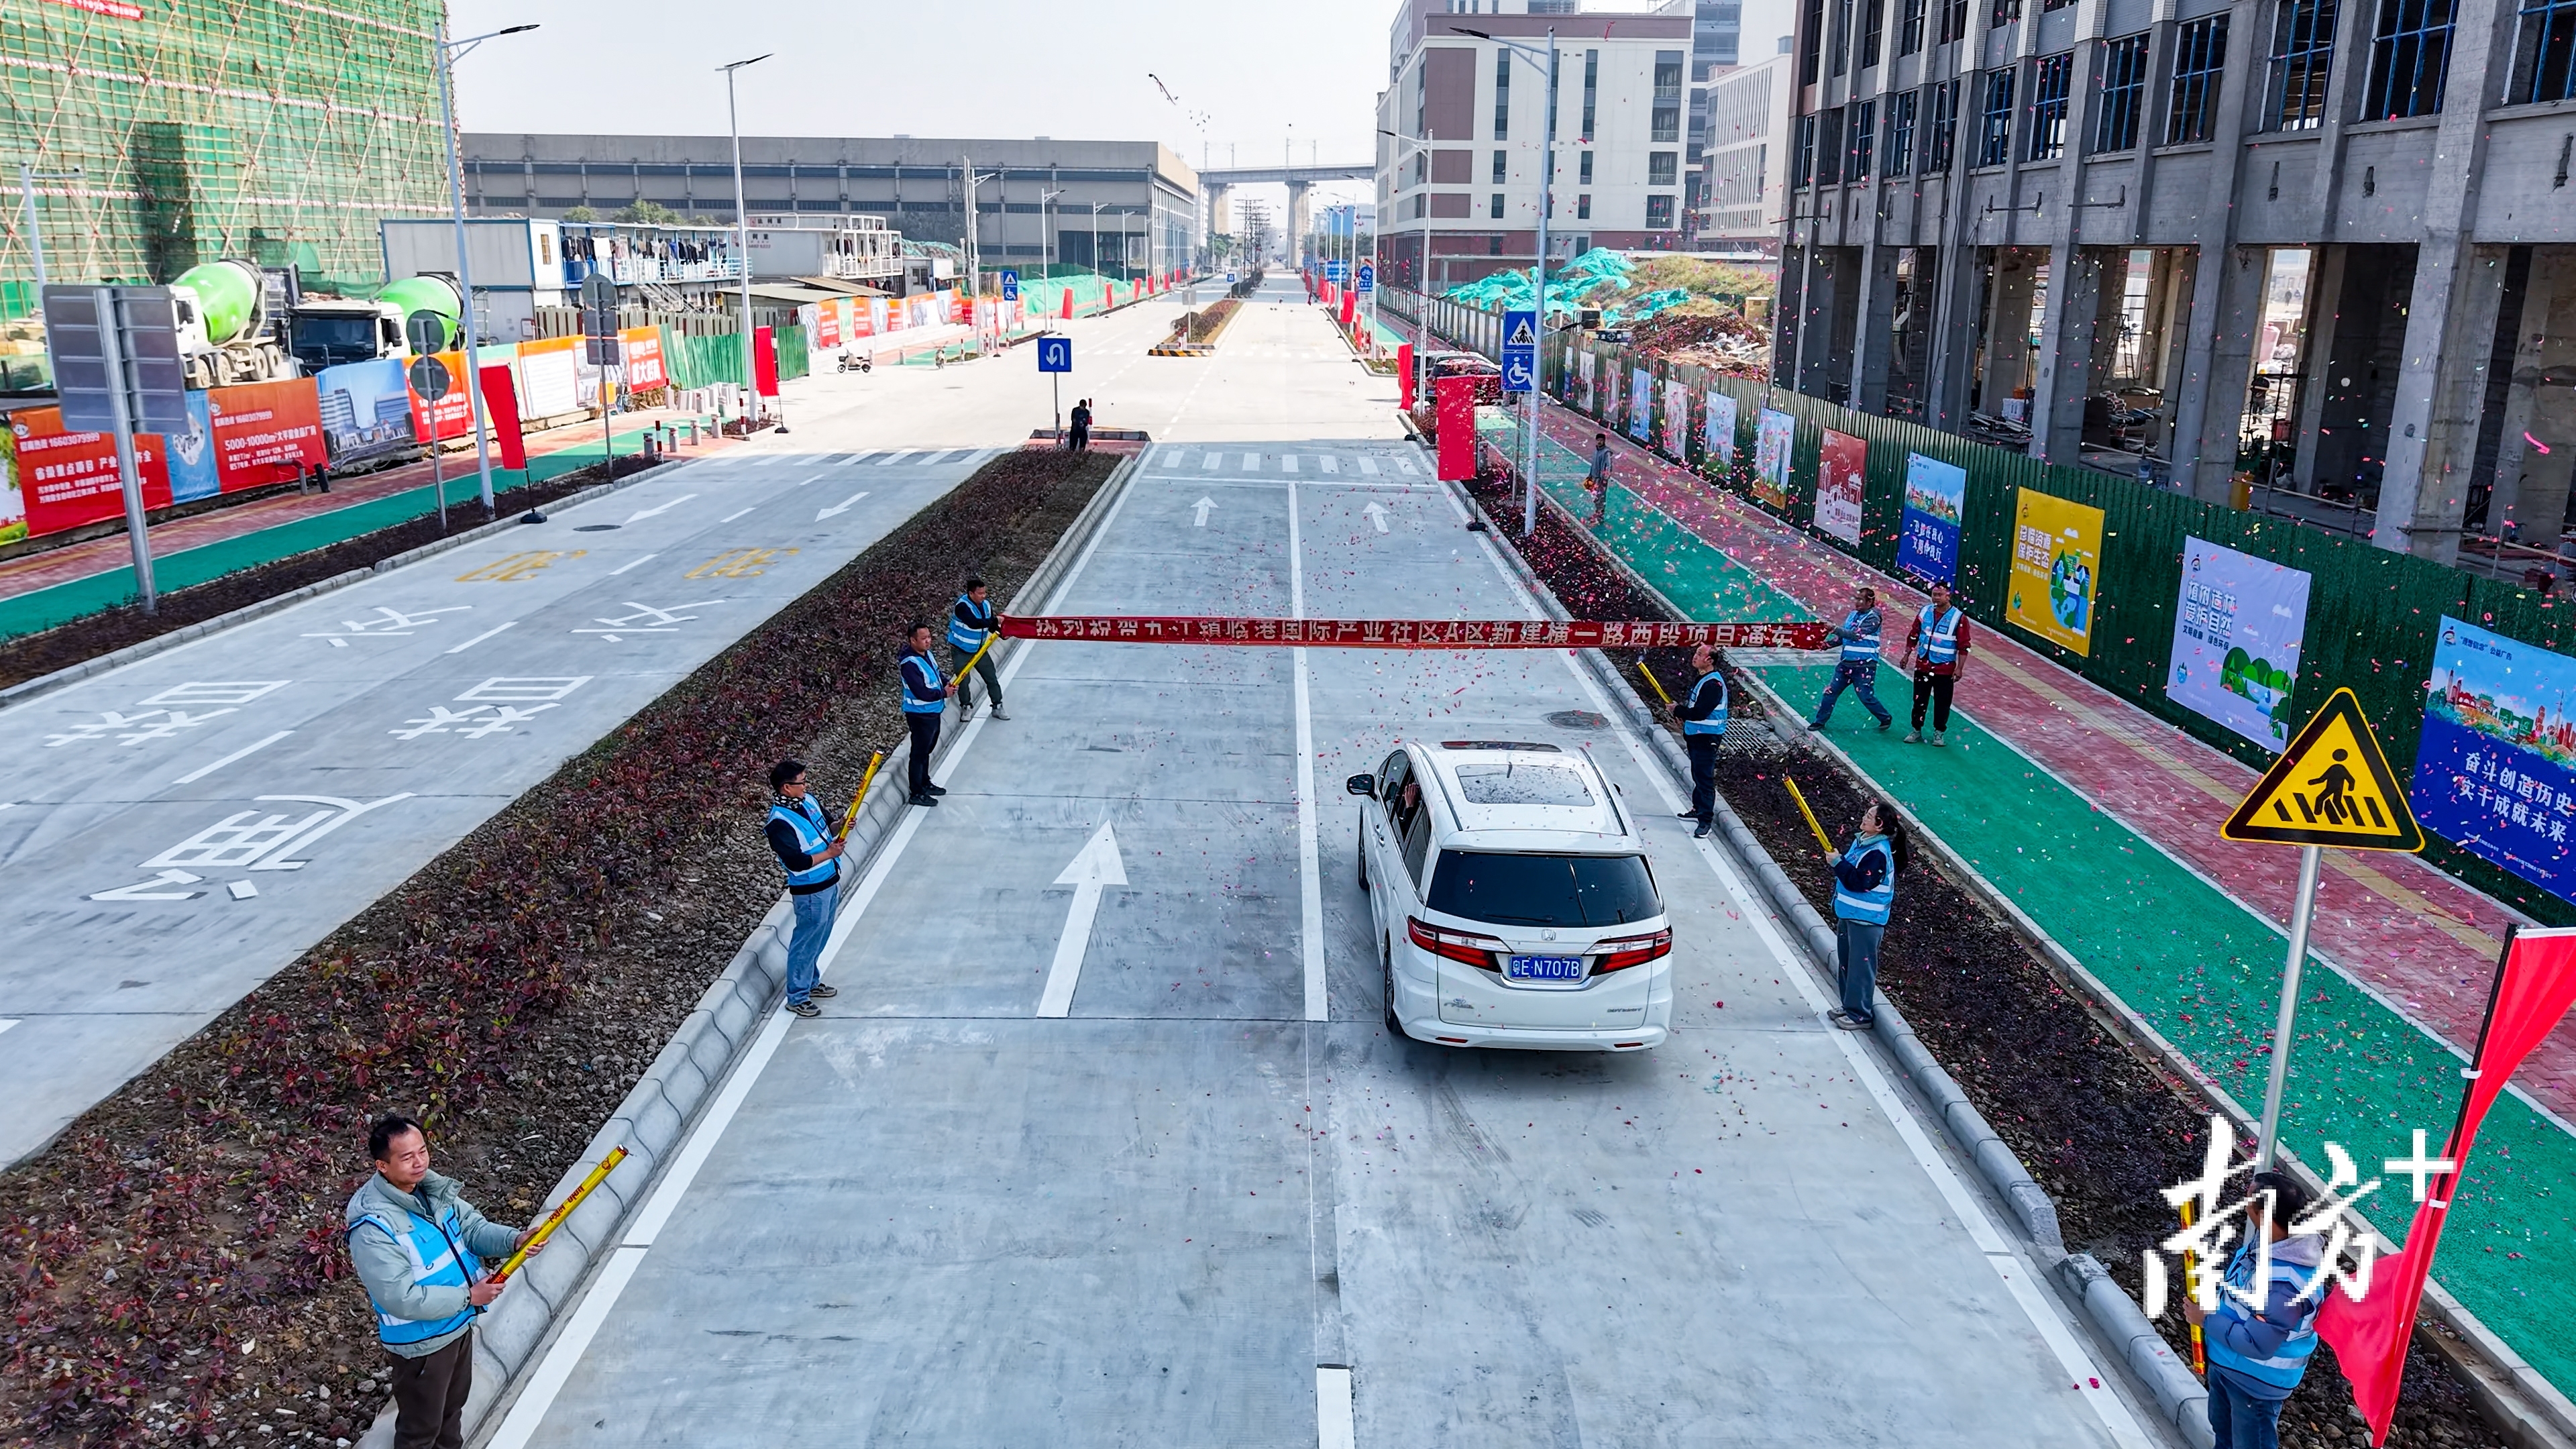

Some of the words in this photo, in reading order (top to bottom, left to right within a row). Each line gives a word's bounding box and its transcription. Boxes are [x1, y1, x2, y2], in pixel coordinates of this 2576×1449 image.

[2018, 542, 2049, 569] 保护生态
[2186, 579, 2237, 616] 植树造林
[2184, 601, 2233, 639] 爱护自然
[2208, 635, 2229, 651] 绿色环保
[2489, 647, 2512, 661] 公益广告
[2465, 751, 2573, 818] 奋斗创造历史
[2459, 776, 2567, 843] 实干成就未来
